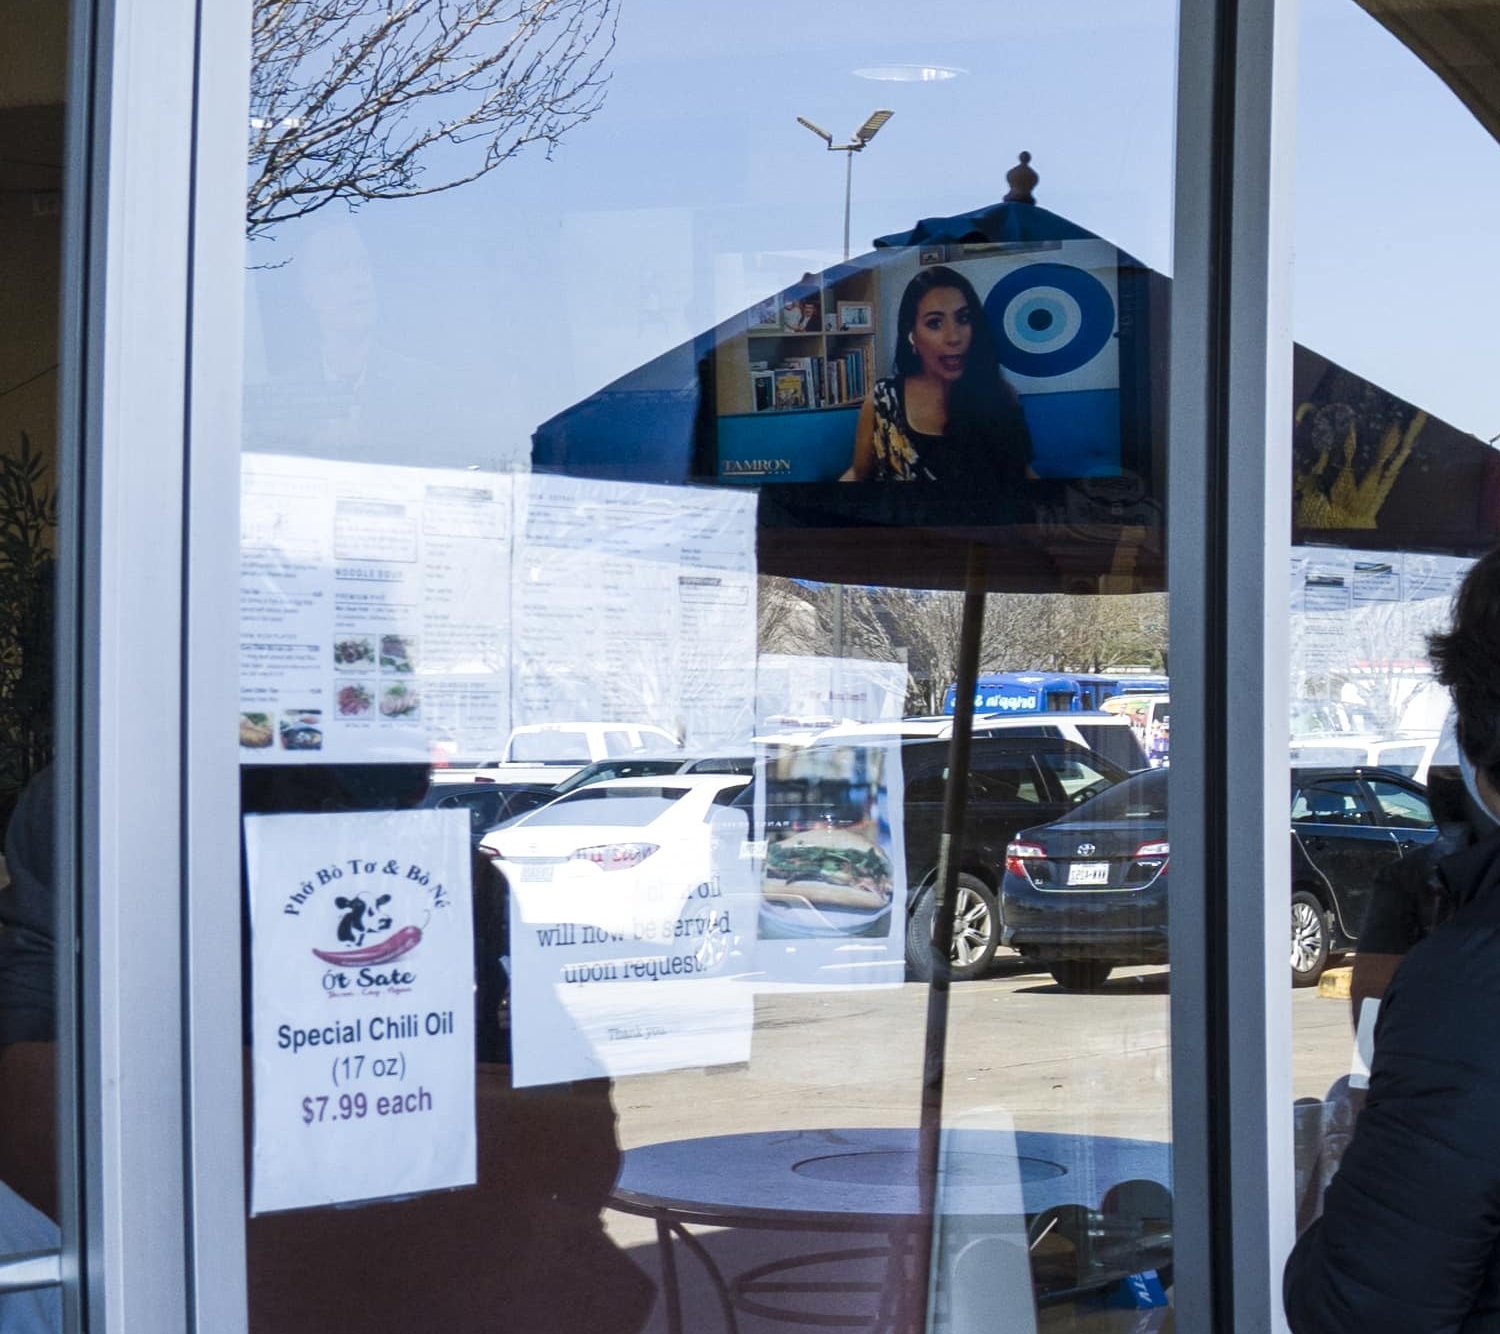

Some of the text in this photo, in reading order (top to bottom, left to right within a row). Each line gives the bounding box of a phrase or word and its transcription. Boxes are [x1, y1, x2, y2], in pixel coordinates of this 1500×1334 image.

[722, 459, 791, 472] TAMRON
[382, 859, 400, 876] &
[536, 922, 577, 947] will
[582, 923, 625, 944] now
[662, 910, 732, 938] served
[356, 967, 417, 988] Sate
[564, 960, 618, 988] upon
[278, 1011, 454, 1054] Special Chili Oil
[332, 1050, 406, 1087] (17 oz)
[302, 1085, 432, 1127] $7.99 each
